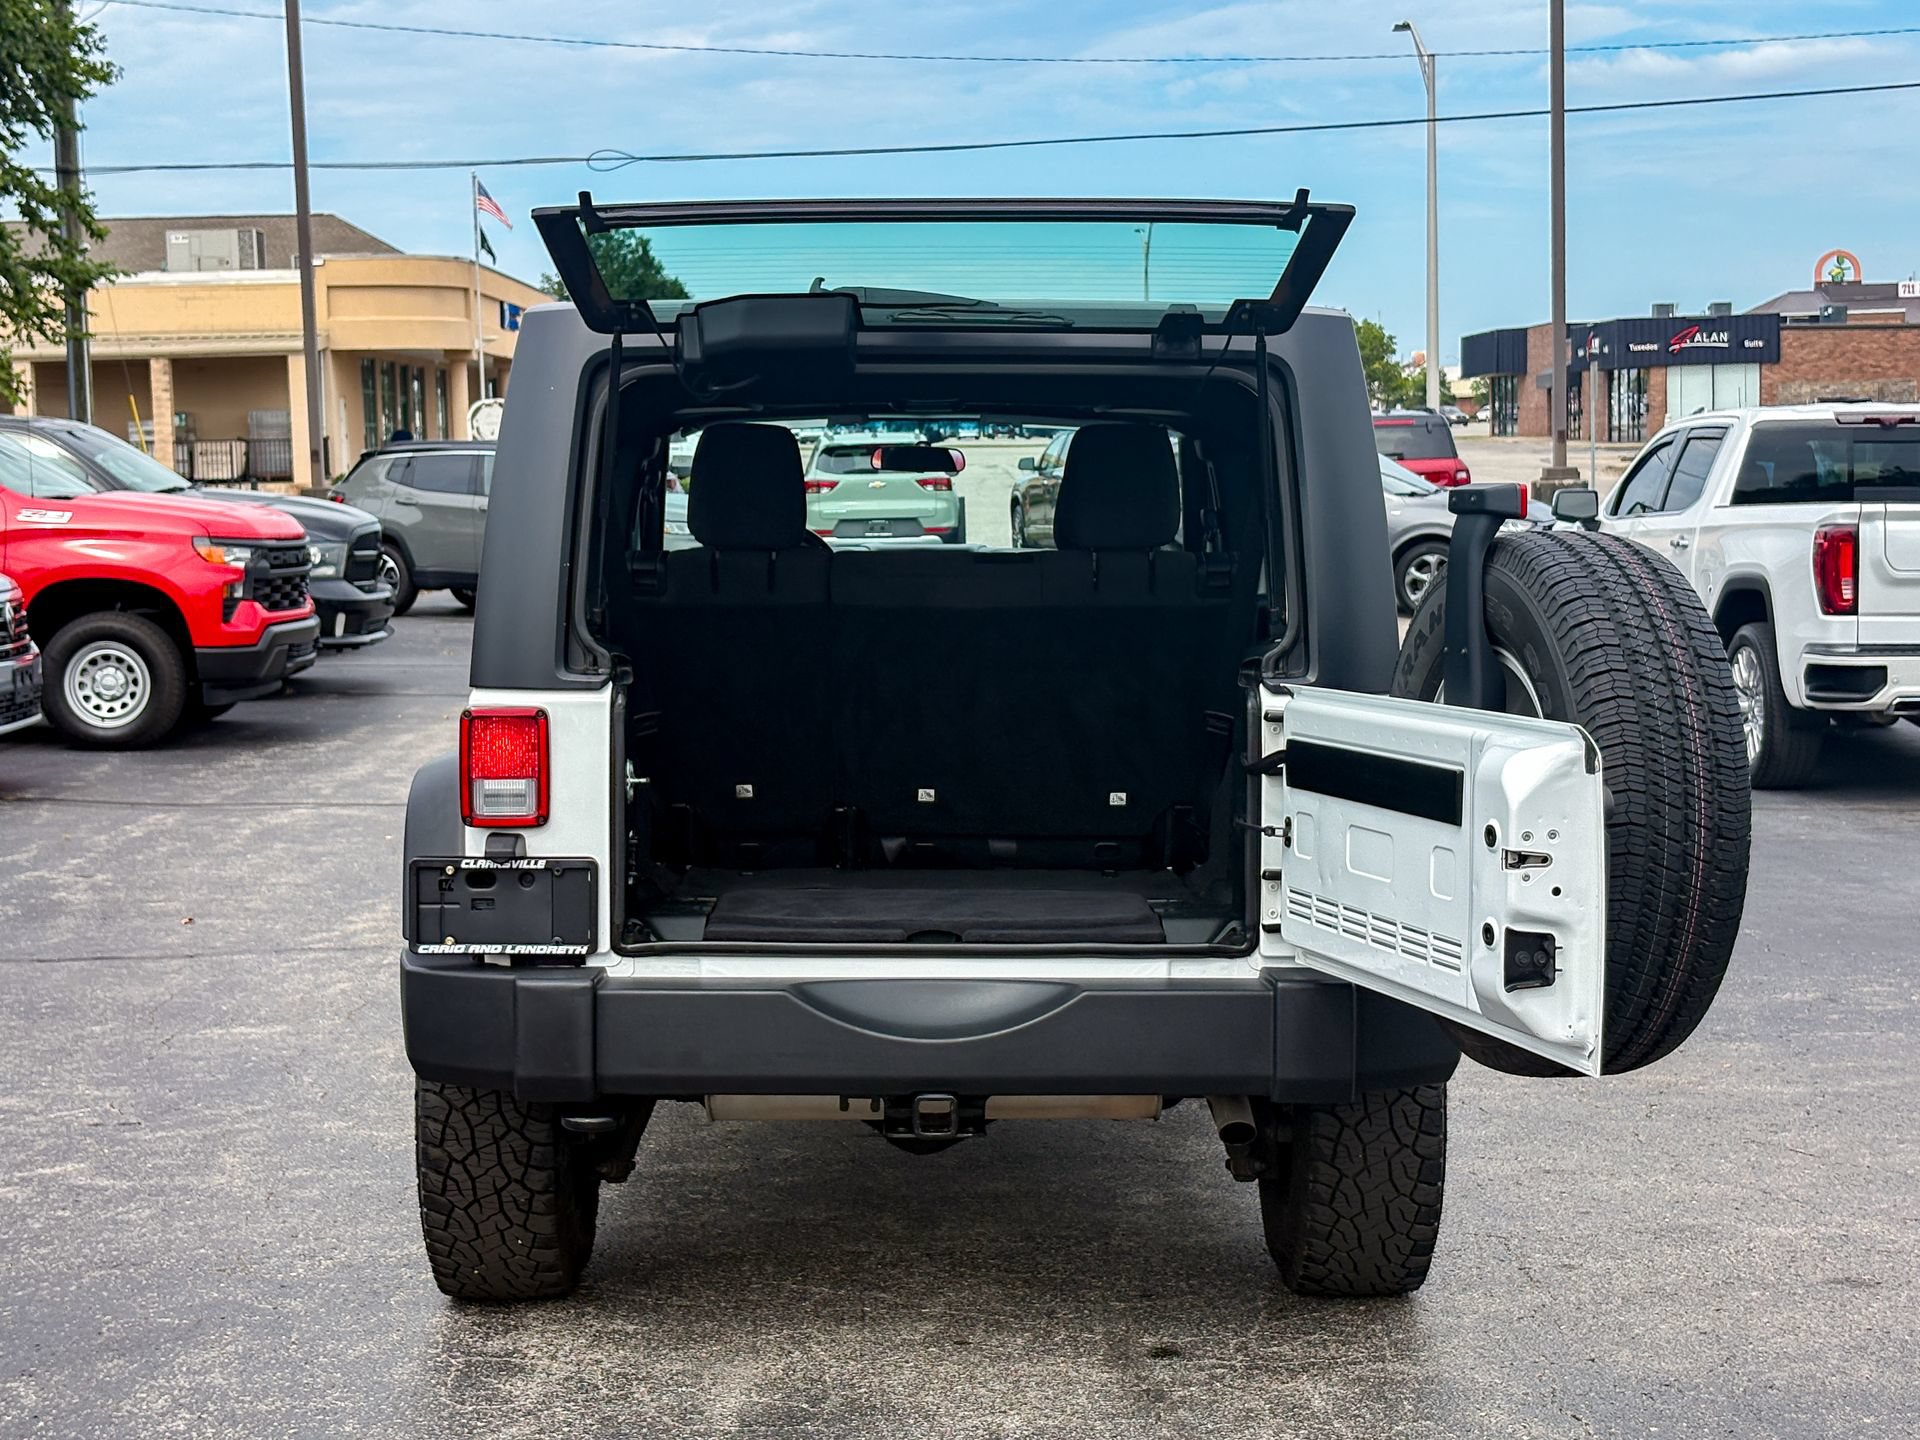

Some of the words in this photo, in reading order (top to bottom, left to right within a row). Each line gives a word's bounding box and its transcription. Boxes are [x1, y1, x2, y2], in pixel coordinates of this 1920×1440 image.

[1694, 332, 1729, 343] ALAN
[418, 944, 465, 954] CRAIG
[467, 944, 502, 955] AND
[505, 944, 588, 955] LANDRETH
